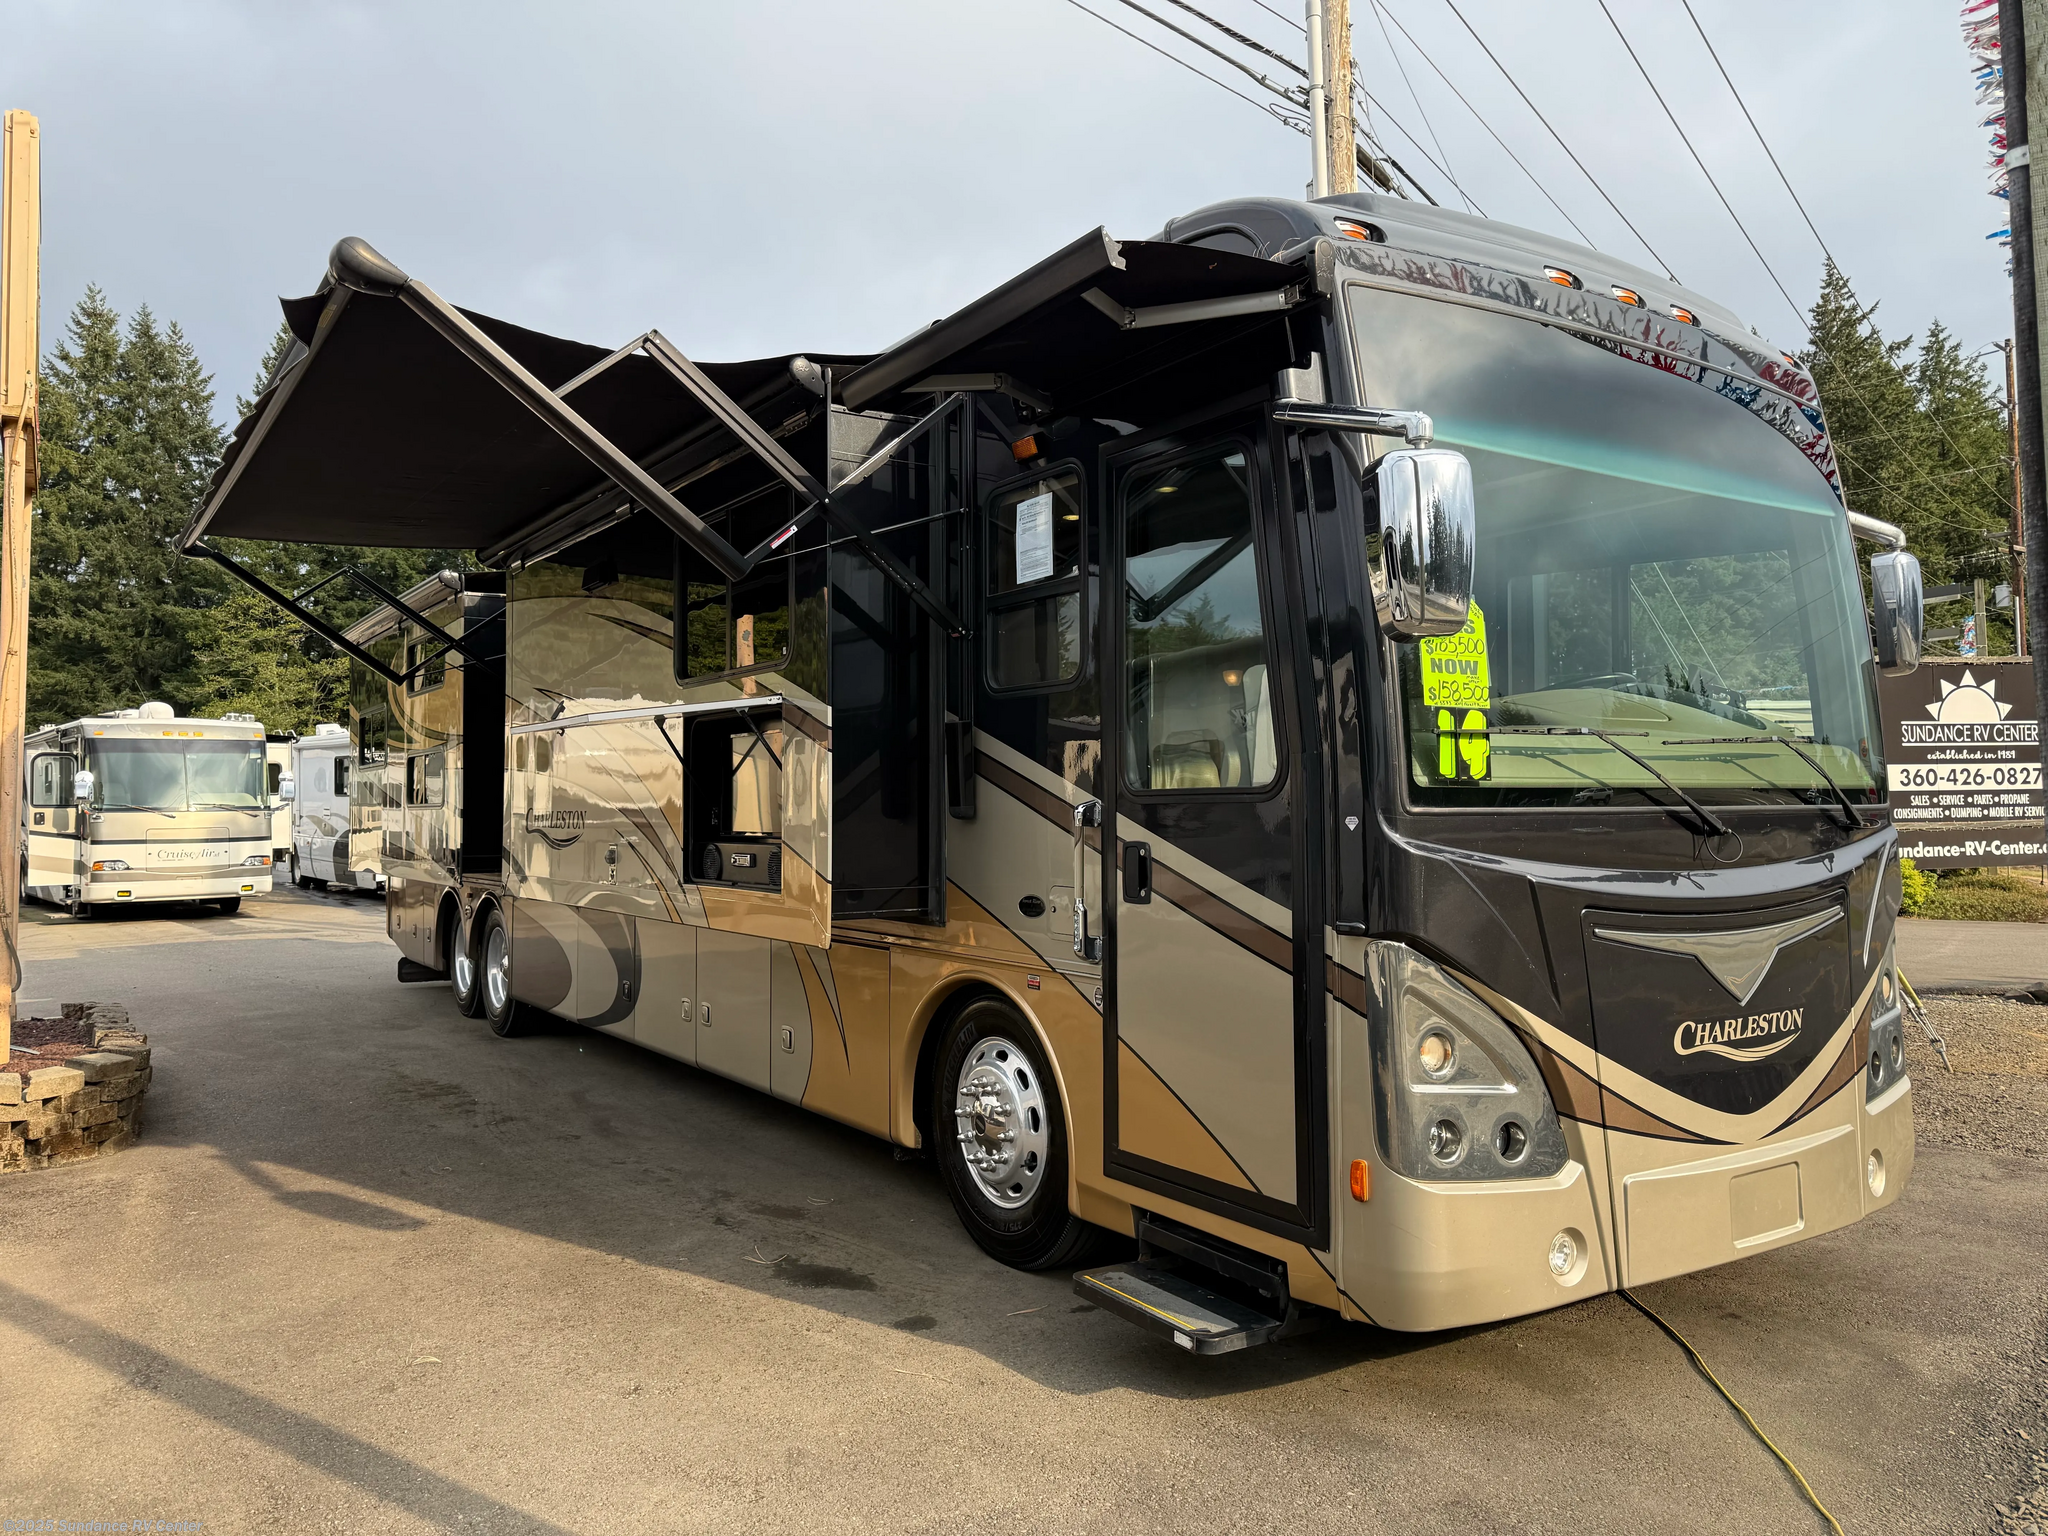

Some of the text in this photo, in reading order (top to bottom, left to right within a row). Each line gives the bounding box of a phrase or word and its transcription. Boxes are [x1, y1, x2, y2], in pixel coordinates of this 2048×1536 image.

[1430, 657, 1479, 676] NOW
[1428, 679, 1490, 703] $158,500
[1901, 724, 2039, 743] SUNDANCE RV CENTER
[1927, 749, 1983, 760] established
[1984, 750, 1997, 759] in
[1899, 767, 2043, 787] 360-426-0827
[1910, 793, 2030, 806] SALES SERVICE PARTS PROPANE
[525, 807, 588, 835] CHARLESTON
[1893, 807, 1944, 819] CONSIGNMENTS
[1950, 807, 1983, 818] DUMPING
[1989, 806, 2014, 818] MOBILE
[2014, 806, 2024, 817] RV
[1673, 1007, 1804, 1056] CHARLESTON
[943, 1023, 975, 1094] MICHELIN
